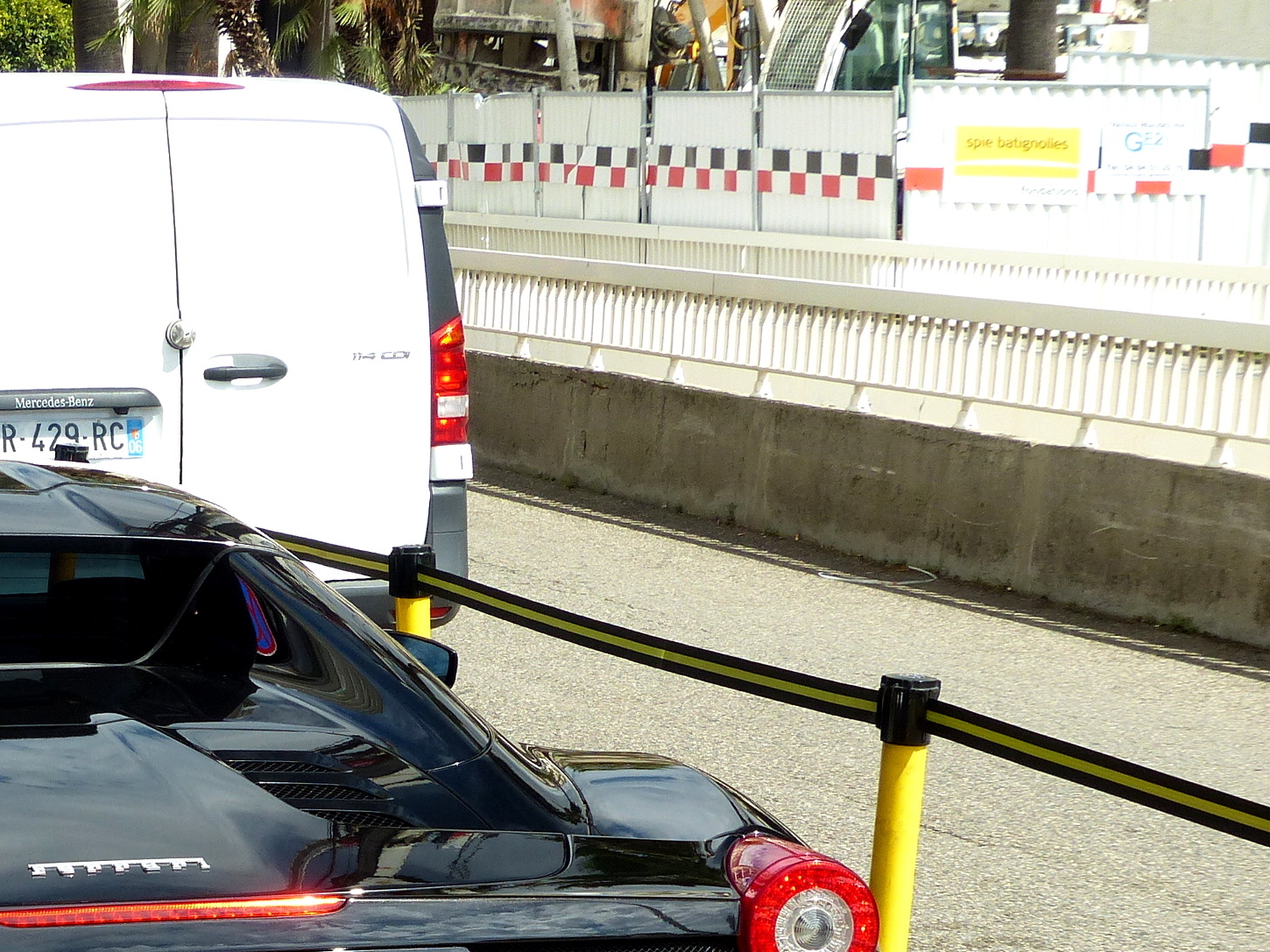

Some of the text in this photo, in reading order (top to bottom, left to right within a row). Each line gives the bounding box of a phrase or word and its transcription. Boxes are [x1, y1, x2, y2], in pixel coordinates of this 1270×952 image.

[966, 136, 1069, 152] spie batignolles
[15, 396, 94, 409] Mercedes-Benz
[128, 440, 143, 454] 06
